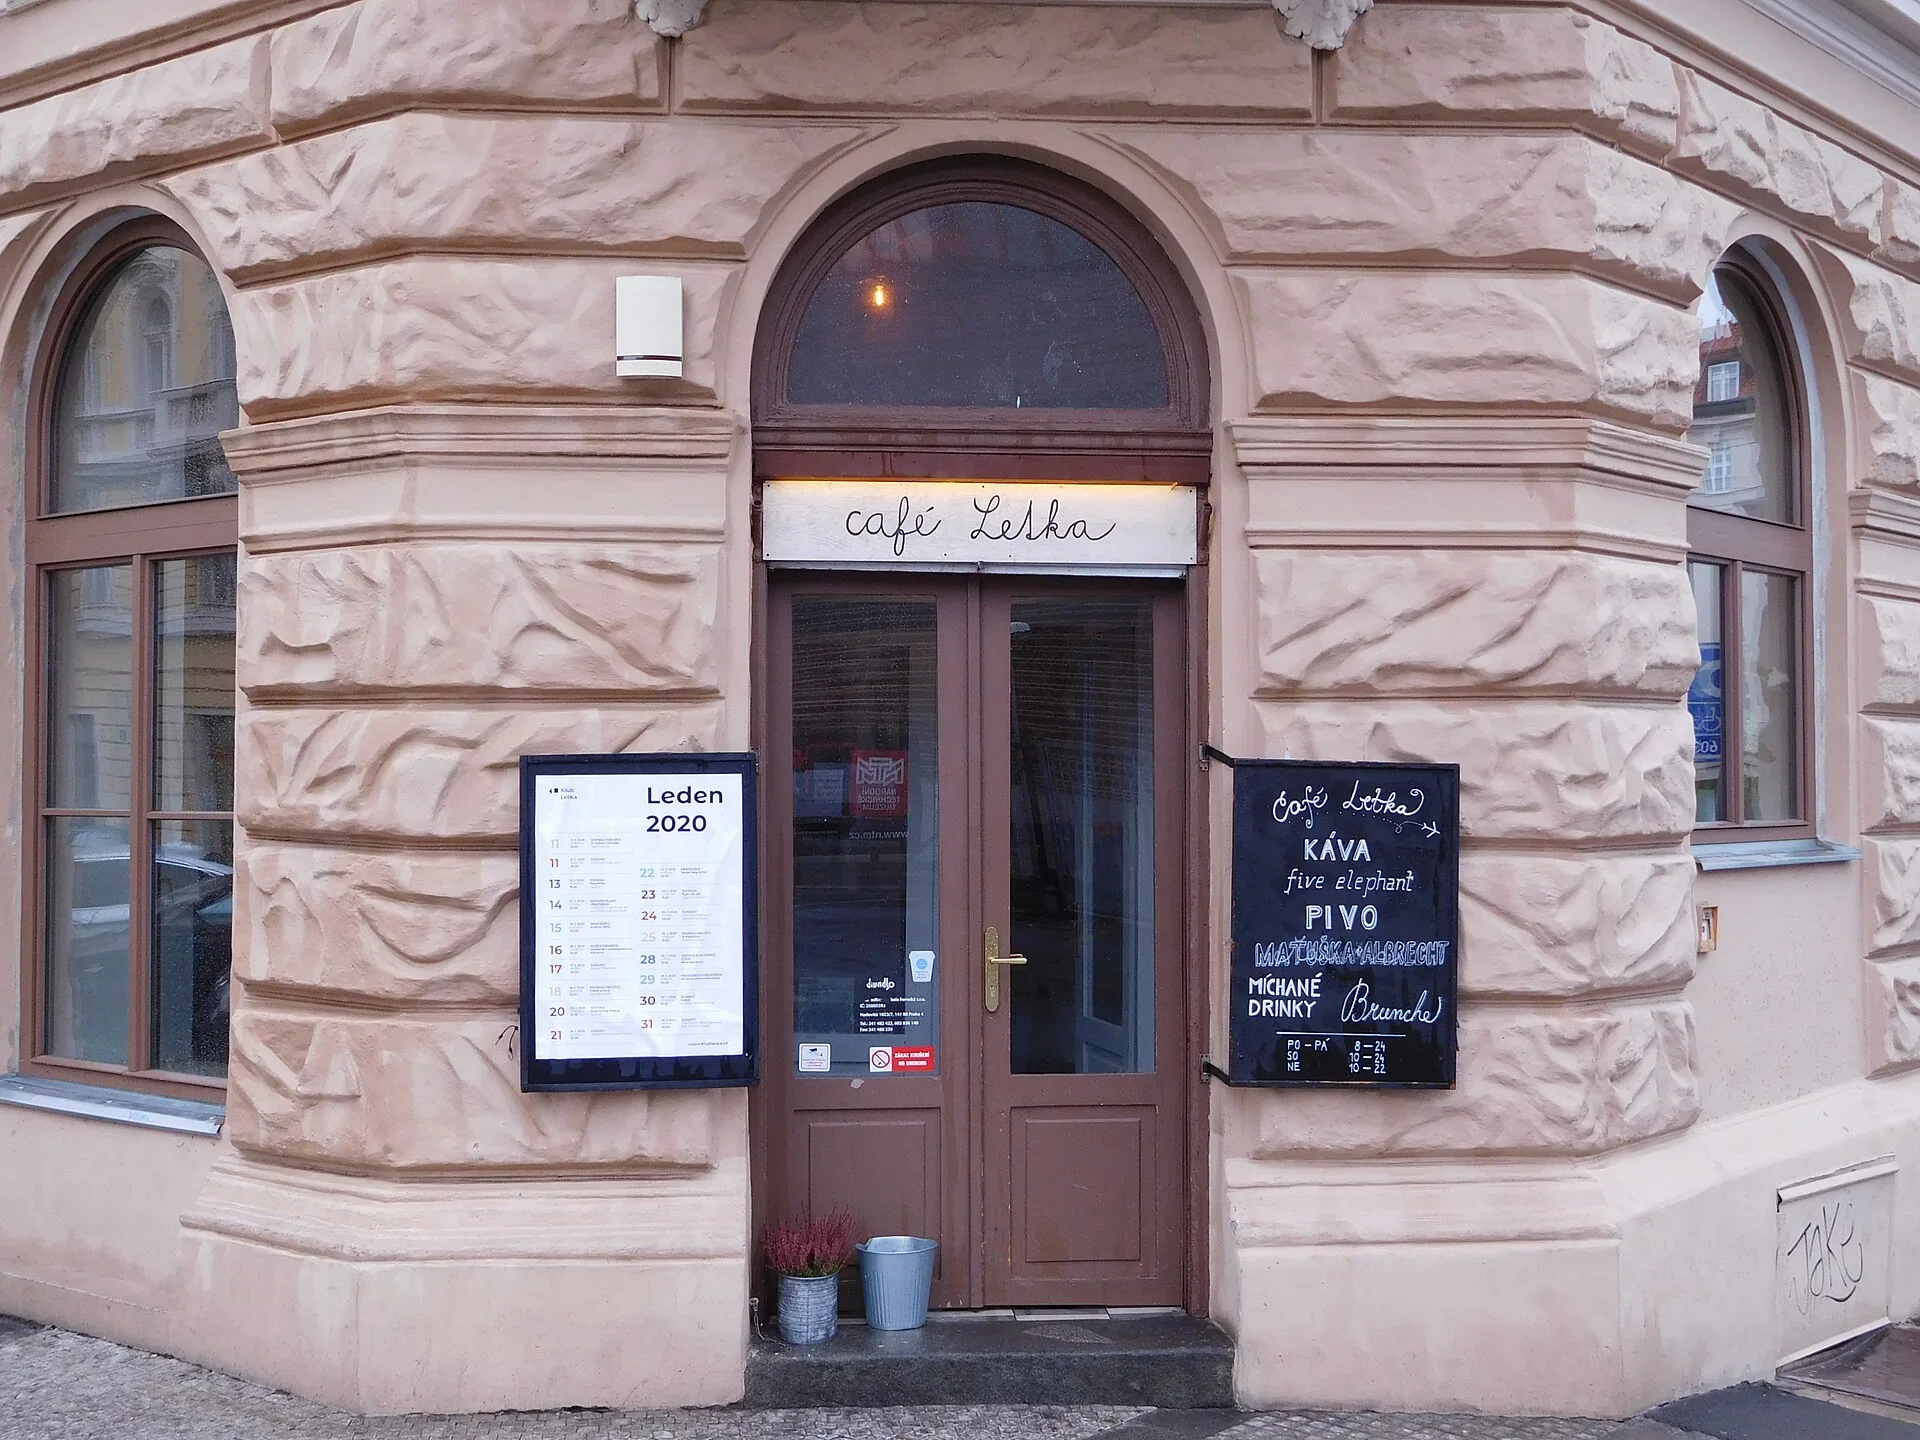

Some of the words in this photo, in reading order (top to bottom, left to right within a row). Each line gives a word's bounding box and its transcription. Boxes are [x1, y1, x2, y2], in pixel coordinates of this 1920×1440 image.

[845, 496, 941, 556] café
[970, 494, 1117, 541] Letka
[648, 786, 724, 804] Leden
[1272, 785, 1328, 829] Café
[1342, 780, 1424, 816] Letka
[646, 814, 708, 832] 2020
[1304, 831, 1371, 861] KÁVA
[549, 858, 559, 868] 11
[640, 868, 655, 878] 22
[549, 880, 561, 889] 13
[1284, 868, 1325, 895] five
[1335, 870, 1414, 898] elephant
[641, 890, 656, 900] 23
[550, 900, 562, 910] 14
[641, 911, 657, 920] 24
[1305, 904, 1378, 930] PIVO
[550, 923, 562, 932] 15
[640, 932, 656, 942] 25
[550, 945, 563, 955] 16
[640, 954, 656, 964] 28
[550, 964, 562, 974] 17
[640, 974, 655, 984] 29
[1248, 972, 1323, 997] MÍCHANÉ
[549, 987, 562, 996] 18
[640, 996, 656, 1006] 30
[550, 1007, 565, 1016] 20
[1248, 1000, 1317, 1018] DRINKY
[641, 1019, 653, 1029] 31
[550, 1031, 562, 1040] 21
[1287, 1040, 1300, 1050] PO
[1314, 1038, 1330, 1051] PÁ
[1354, 1041, 1361, 1051] 8
[1374, 1041, 1386, 1052] 24
[1287, 1051, 1298, 1060] SO
[1349, 1052, 1360, 1062] 10
[1374, 1053, 1385, 1063] 24
[1288, 1062, 1300, 1072] NE
[1349, 1063, 1360, 1073] 10
[1374, 1064, 1386, 1074] 22
